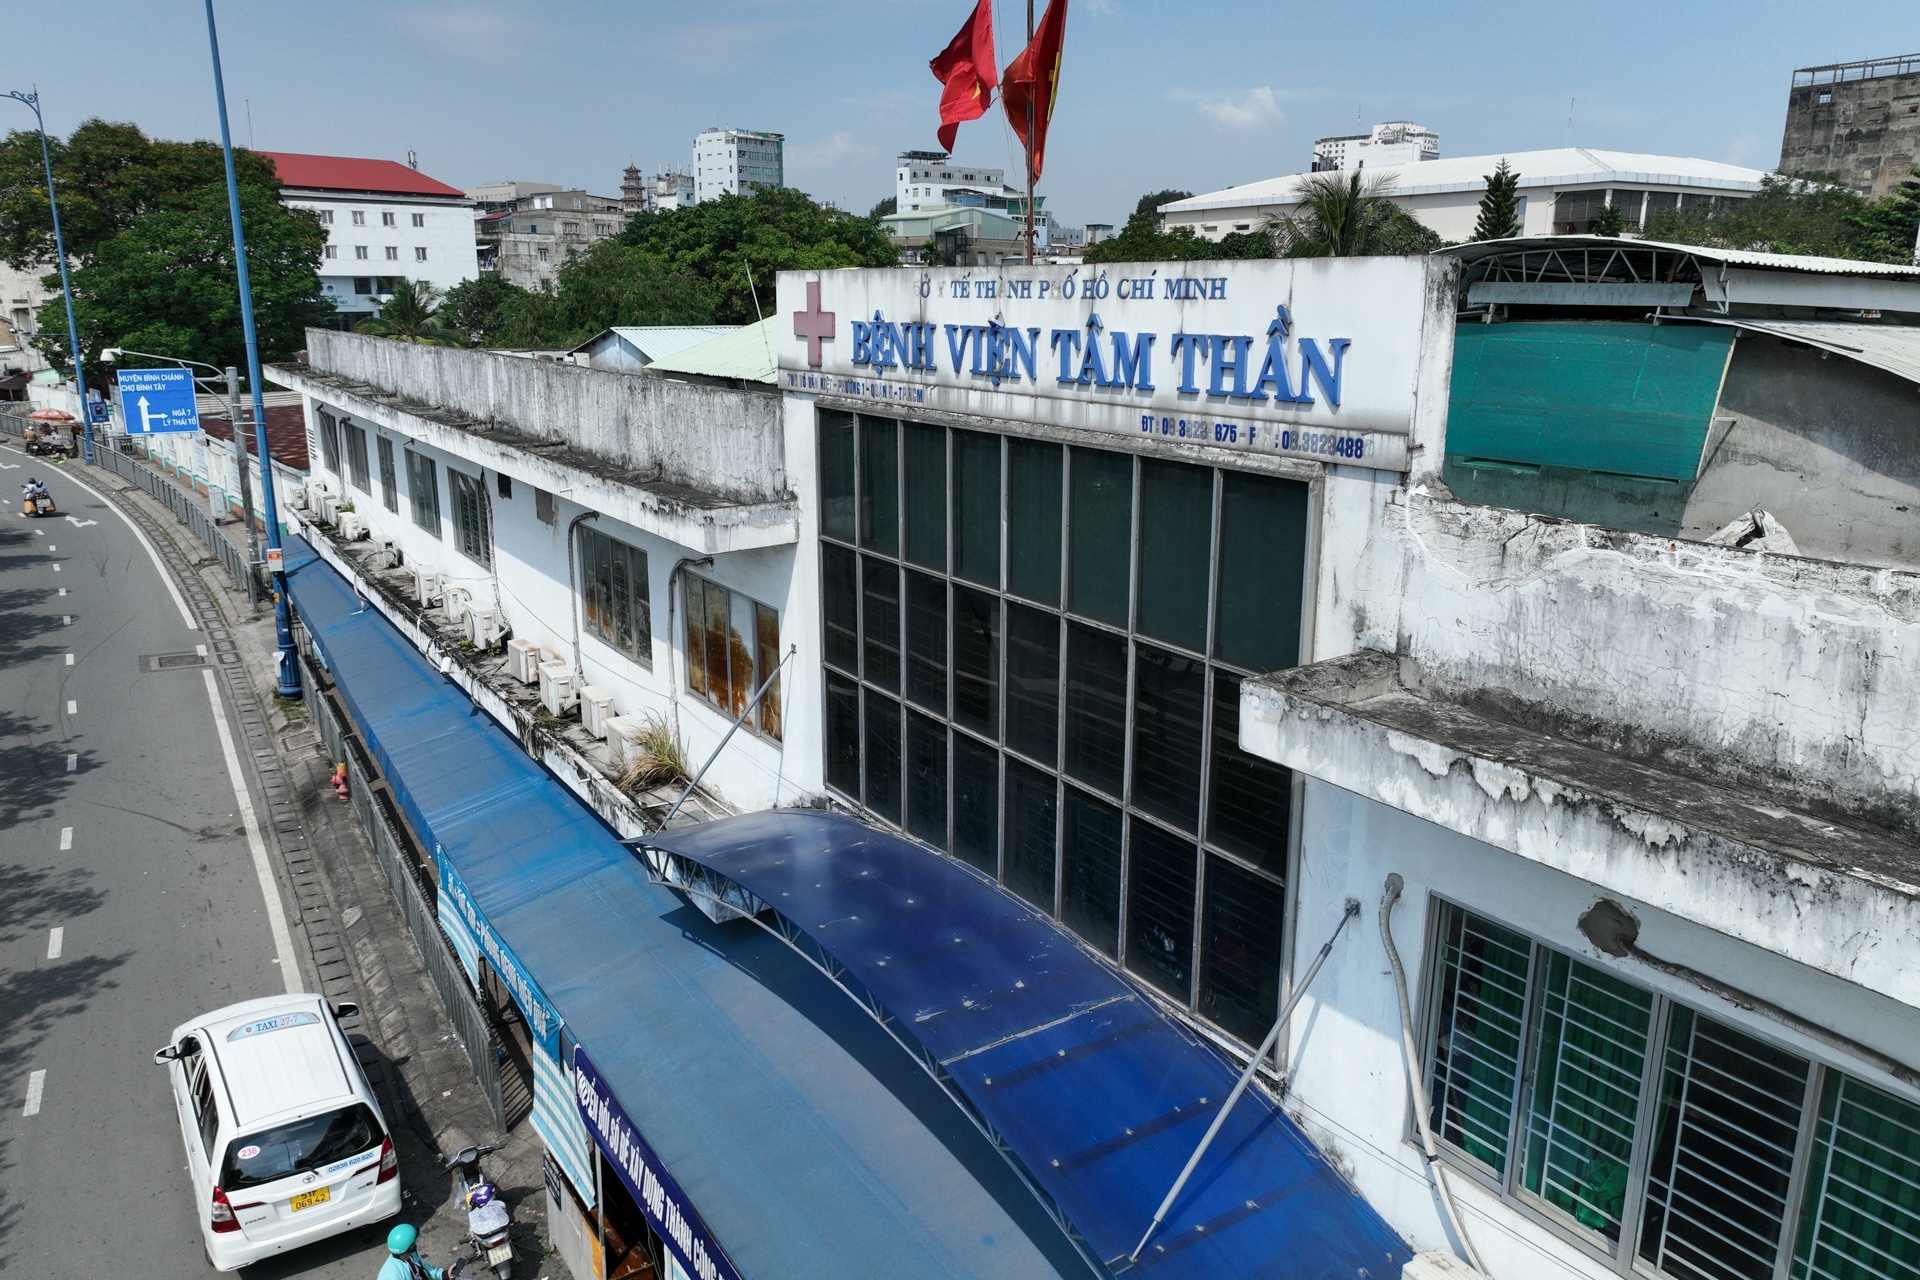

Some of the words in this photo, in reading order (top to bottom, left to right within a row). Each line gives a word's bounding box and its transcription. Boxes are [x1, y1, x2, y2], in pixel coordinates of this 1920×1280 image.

[951, 271, 970, 299] TẾ
[1080, 269, 1110, 300] HỒ
[1116, 268, 1157, 300] CHÍ
[1163, 277, 1228, 300] MINH
[851, 309, 937, 375] BỆNH
[1050, 313, 1157, 390] TÂM
[1170, 303, 1352, 406] THẦN
[120, 374, 143, 383] HUYỆN
[143, 372, 160, 381] BÌNH
[161, 372, 184, 381] CHÁNH
[121, 384, 135, 392] CHỢ
[136, 383, 153, 391] BÌNH
[154, 382, 166, 391] TÂY
[172, 417, 188, 426] THÁI
[256, 1019, 278, 1032] TAXI
[280, 1014, 299, 1026] 27-7
[241, 1147, 257, 1157] 236
[597, 1097, 610, 1141] ĐỔI
[609, 1115, 621, 1155] SỐ
[619, 1127, 631, 1171] ĐỂ
[628, 1146, 644, 1190] XÂY
[642, 1165, 665, 1222] DỰNG
[665, 1195, 692, 1262] THÀNH
[295, 1193, 326, 1210] 069.42
